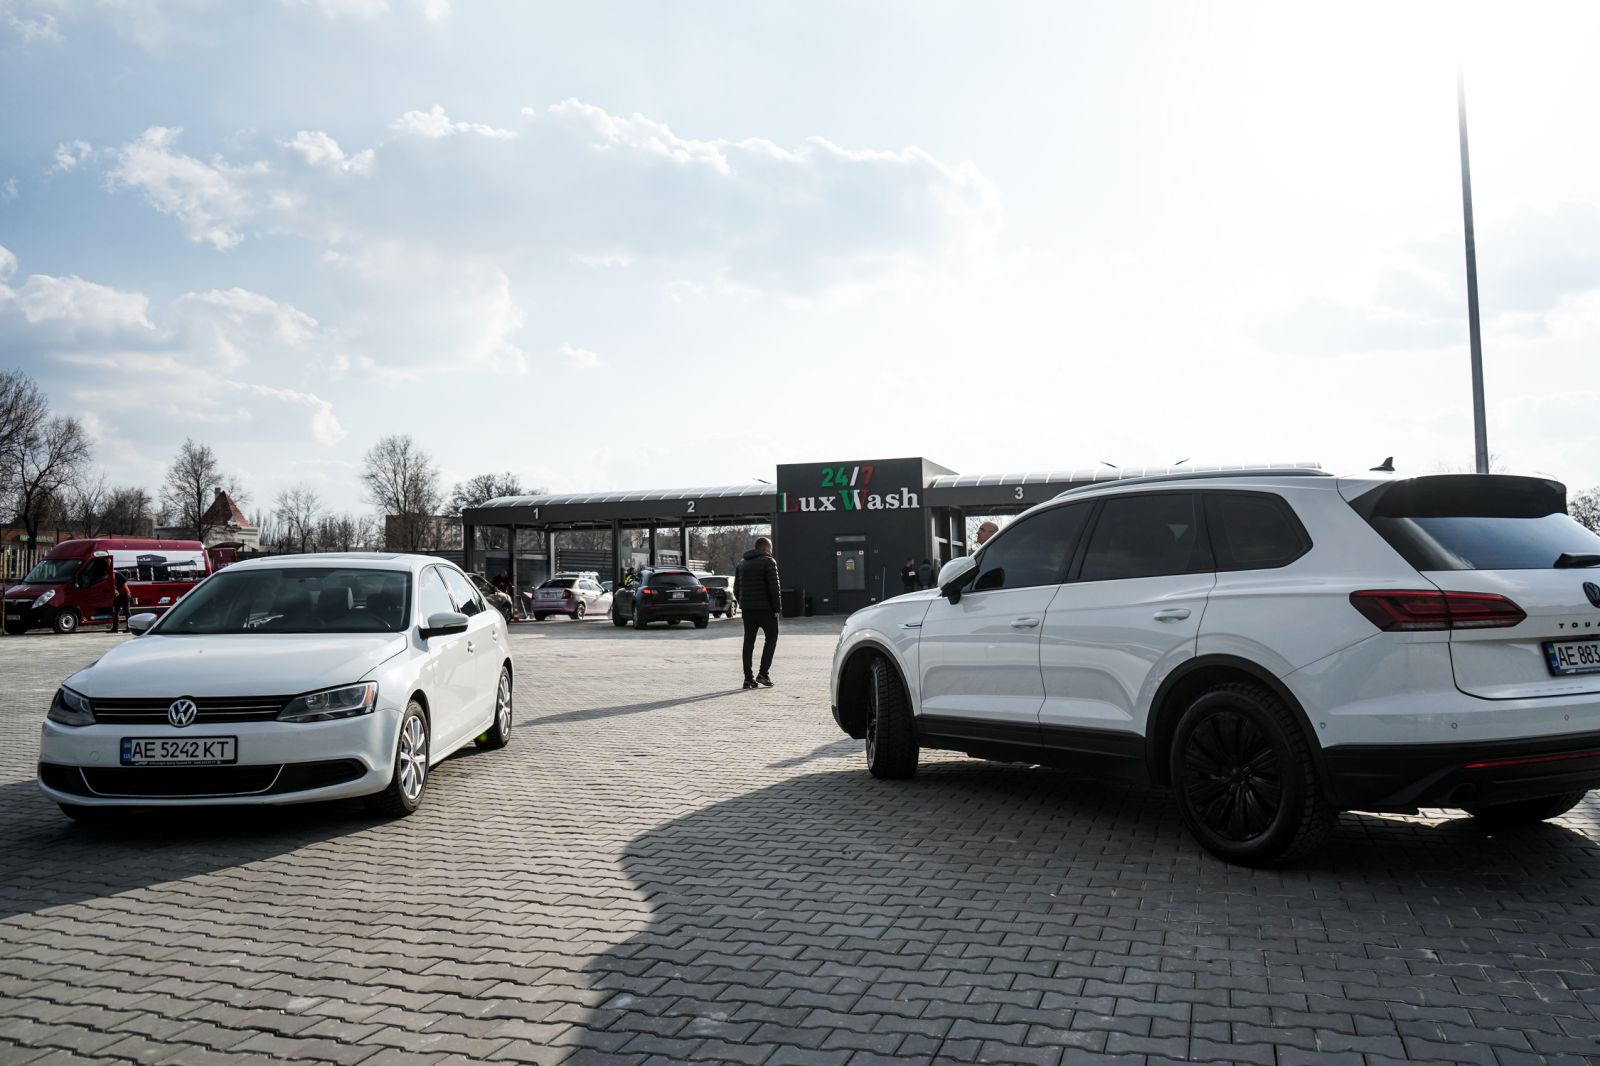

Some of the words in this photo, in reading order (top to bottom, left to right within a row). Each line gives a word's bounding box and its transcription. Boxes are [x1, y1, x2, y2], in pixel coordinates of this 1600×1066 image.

[821, 466, 874, 487] 24/7
[1015, 486, 1024, 500] 3
[533, 507, 539, 520] 1
[687, 501, 695, 513] 2
[1558, 646, 1578, 667] AE
[132, 742, 156, 758] AE
[160, 741, 200, 758] 5242
[203, 741, 229, 758] KT
